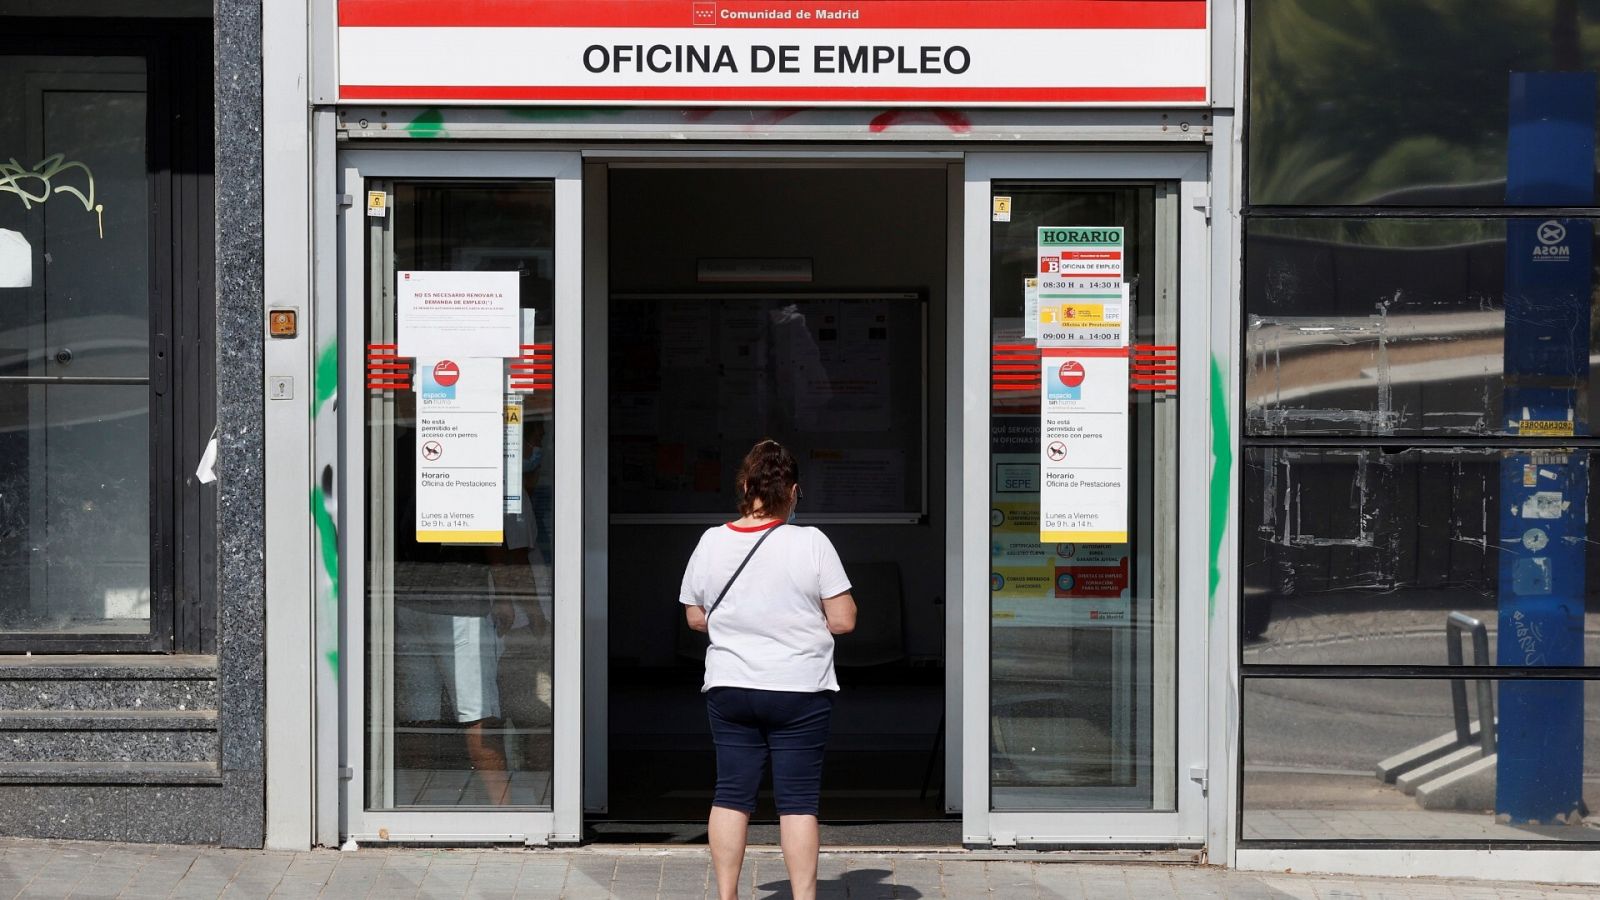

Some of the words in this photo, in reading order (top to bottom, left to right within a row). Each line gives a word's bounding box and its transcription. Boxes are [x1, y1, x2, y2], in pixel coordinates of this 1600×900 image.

[720, 8, 792, 20] Comunidad
[795, 8, 812, 20] de
[816, 8, 860, 20] Madrid
[582, 44, 739, 74] OFICINA
[750, 44, 800, 74] DE
[813, 44, 972, 74] EMPLEO
[1043, 231, 1120, 242] HORARIO
[1048, 262, 1059, 272] B
[1005, 479, 1031, 488] SEPE
